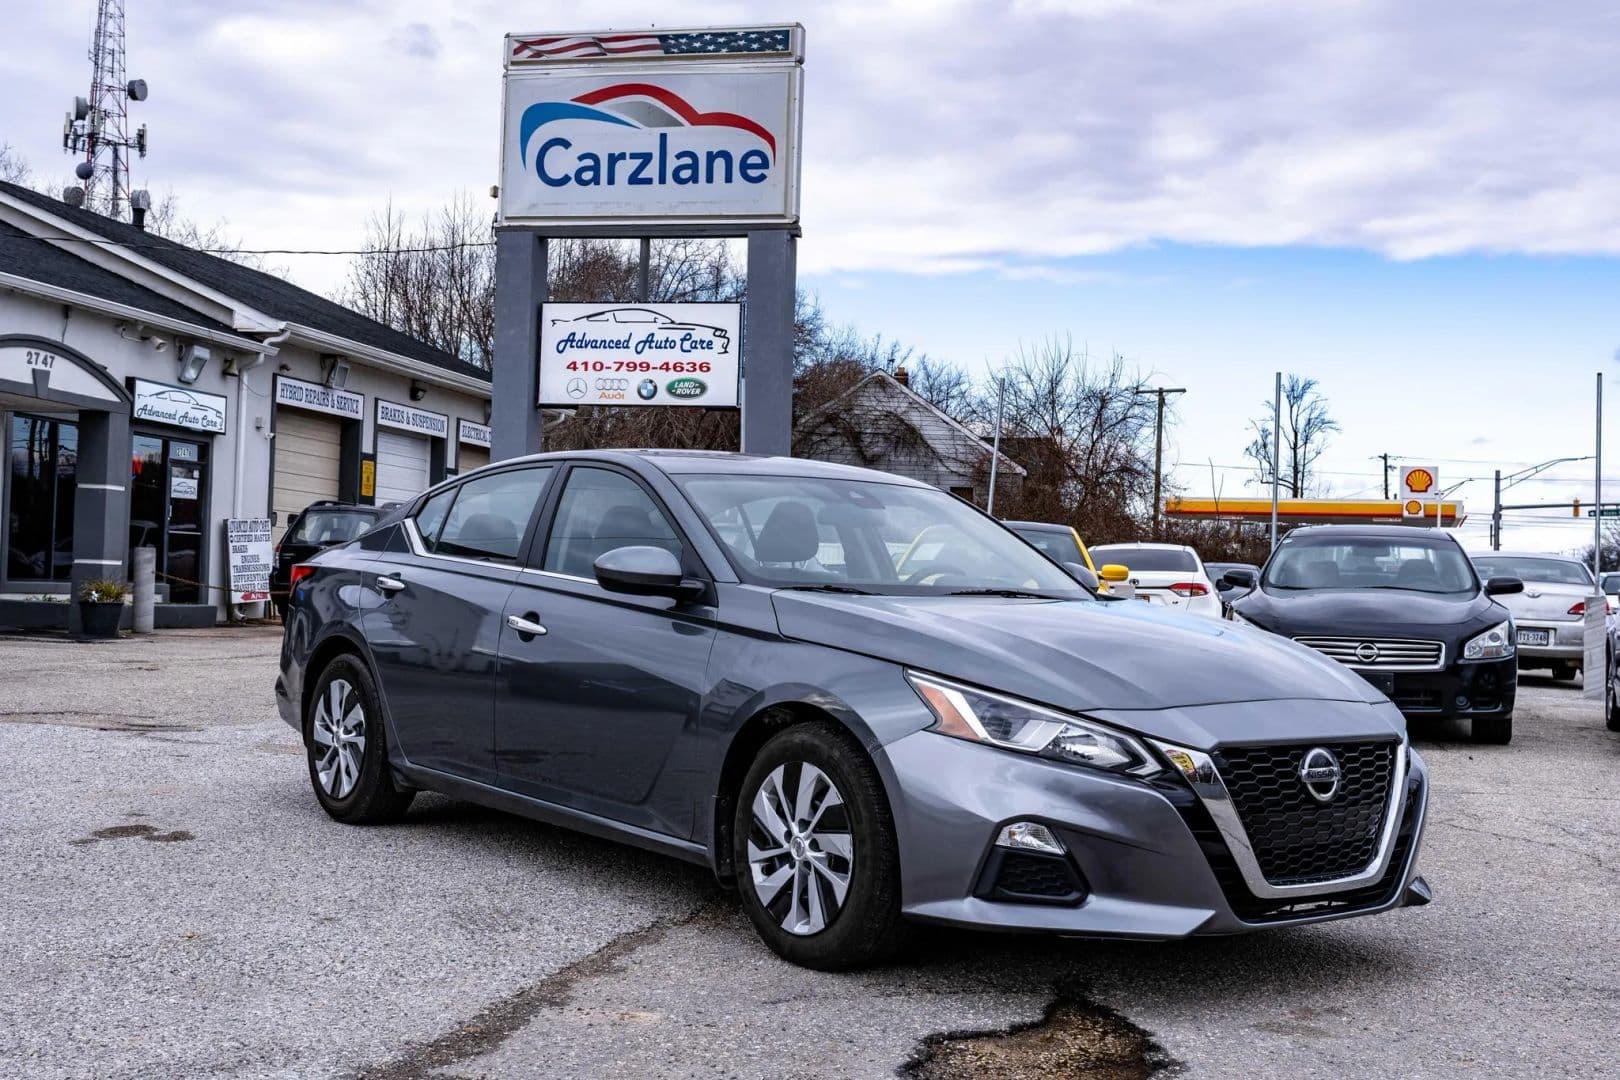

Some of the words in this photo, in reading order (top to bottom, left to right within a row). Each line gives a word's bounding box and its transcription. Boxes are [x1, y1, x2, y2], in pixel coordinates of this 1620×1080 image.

[536, 132, 770, 188] Carzlane
[556, 331, 633, 354] Advanced
[635, 332, 676, 355] Auto
[680, 332, 714, 353] Care
[26, 350, 55, 368] 2747
[566, 361, 711, 373] 410-799-4636
[280, 382, 304, 402] HYBRID
[304, 388, 330, 408] REPAIRS
[330, 394, 335, 409] &
[336, 395, 360, 414] SERVICE
[598, 391, 625, 400] Audi
[136, 403, 178, 420] Advanced
[178, 411, 199, 425] Auto
[201, 414, 218, 428] Care
[380, 405, 405, 424] BRAKES
[405, 411, 411, 425] &
[411, 412, 445, 433] SUSPENSION
[462, 424, 487, 443] ELECTRICAL
